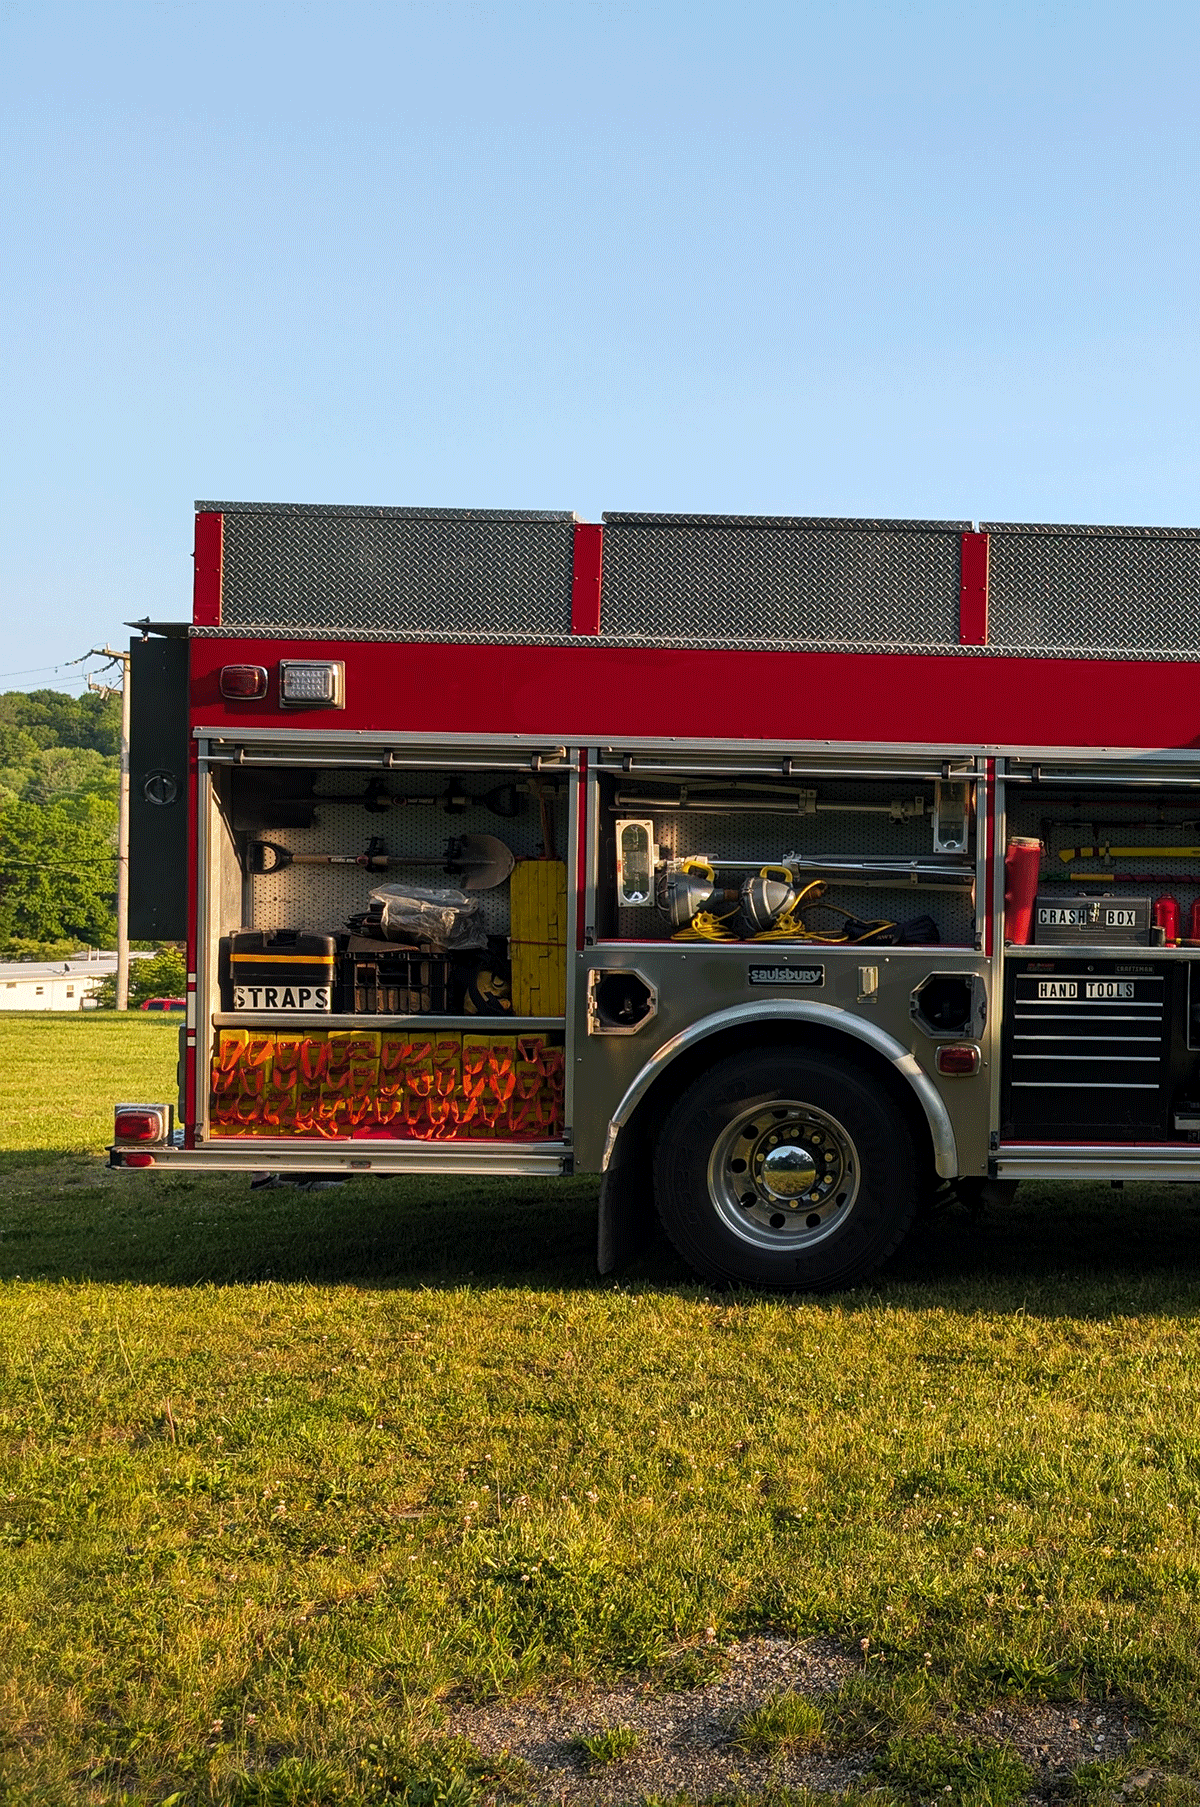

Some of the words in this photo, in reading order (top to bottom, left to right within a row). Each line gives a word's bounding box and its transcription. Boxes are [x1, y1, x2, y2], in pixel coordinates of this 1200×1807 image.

[1040, 909, 1086, 924] CRASH
[1107, 911, 1134, 925] BOX
[751, 967, 821, 983] saulsbury
[1116, 965, 1154, 973] CRAFTSMAN
[235, 987, 328, 1009] STRAPS
[1040, 983, 1076, 997] HAND
[1088, 983, 1133, 997] TOOLS
